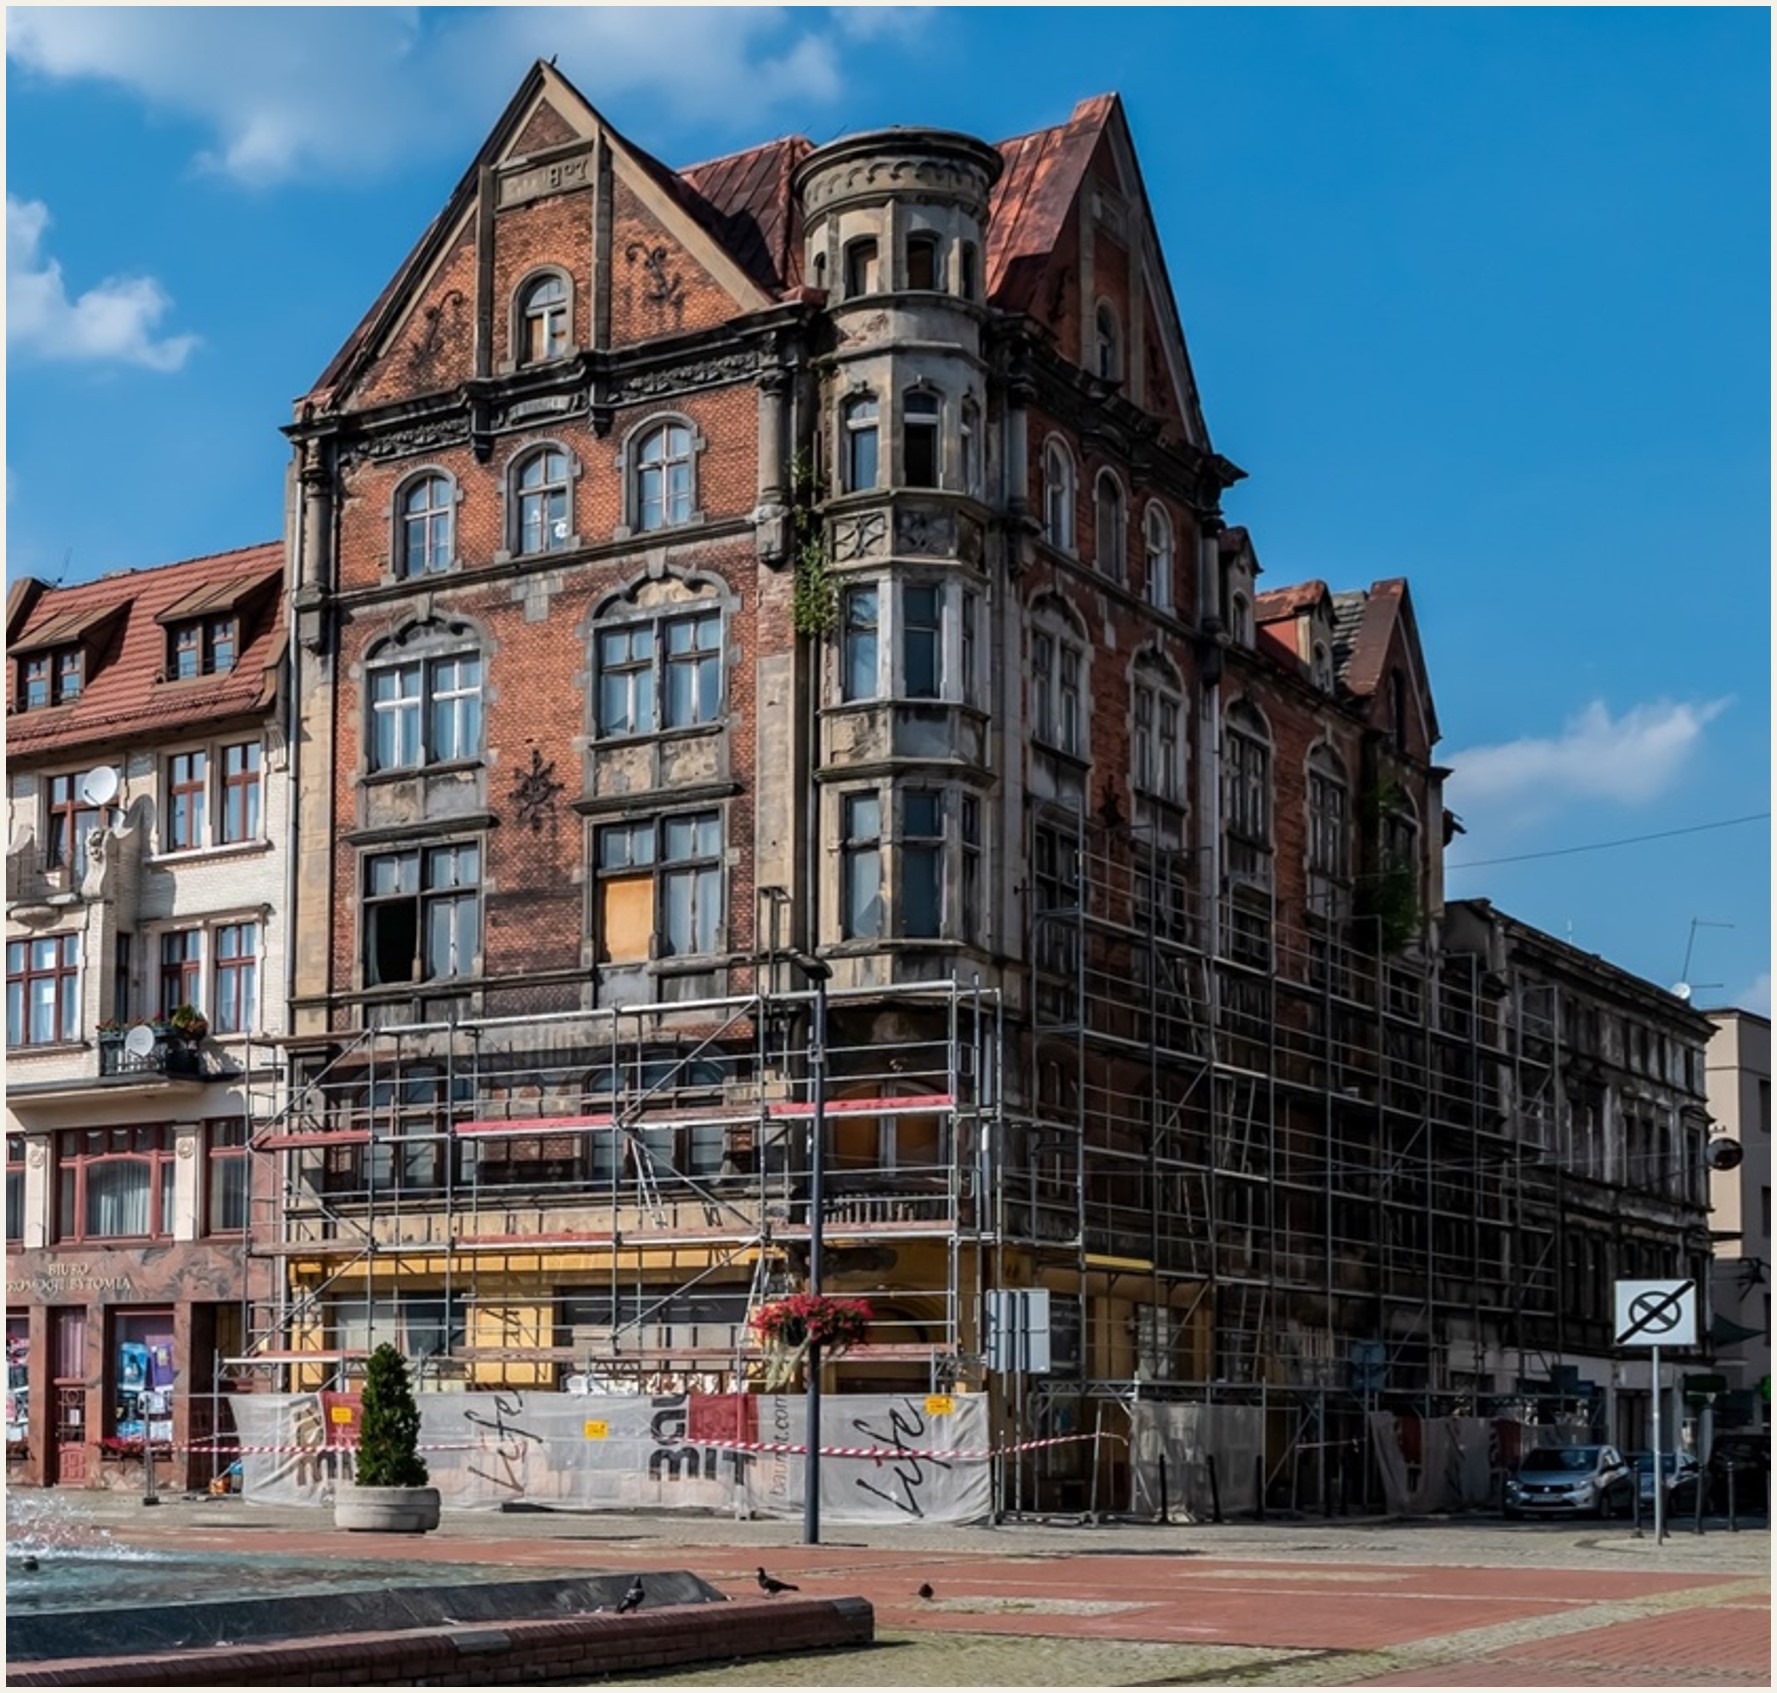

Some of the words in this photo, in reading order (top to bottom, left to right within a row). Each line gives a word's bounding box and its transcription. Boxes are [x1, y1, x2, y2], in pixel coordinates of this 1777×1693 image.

[6, 1278, 64, 1296] ROMOCJI
[69, 1277, 131, 1290] BYTOMIA
[48, 1263, 88, 1276] BIURO
[769, 1394, 790, 1489] baumt.com
[852, 1397, 952, 1518] Life
